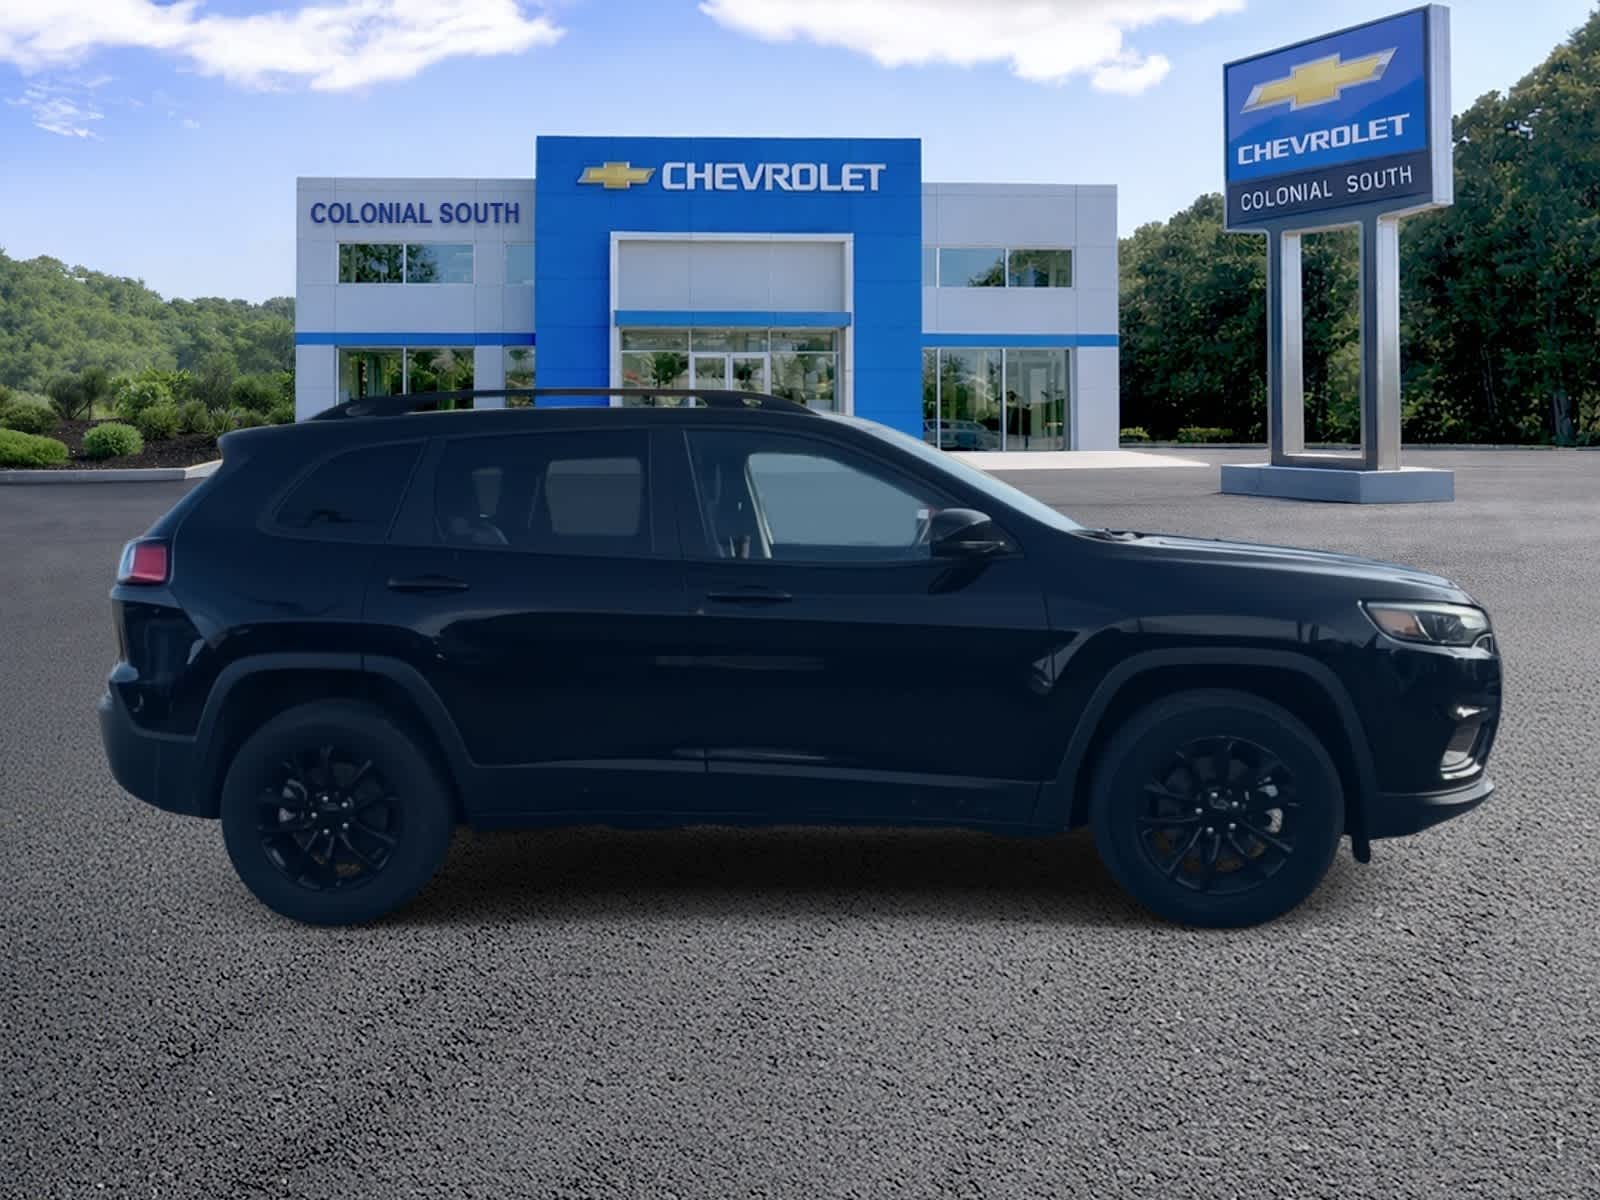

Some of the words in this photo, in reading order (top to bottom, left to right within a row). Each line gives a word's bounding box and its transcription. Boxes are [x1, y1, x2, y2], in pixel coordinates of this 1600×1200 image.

[1238, 113, 1410, 165] CHEVROLET
[661, 162, 887, 193] CHEVROLET
[1241, 180, 1333, 211] COLONIAL
[1346, 165, 1412, 193] SOUTH
[310, 202, 433, 225] COLONIAL
[438, 202, 521, 225] SOUTH
